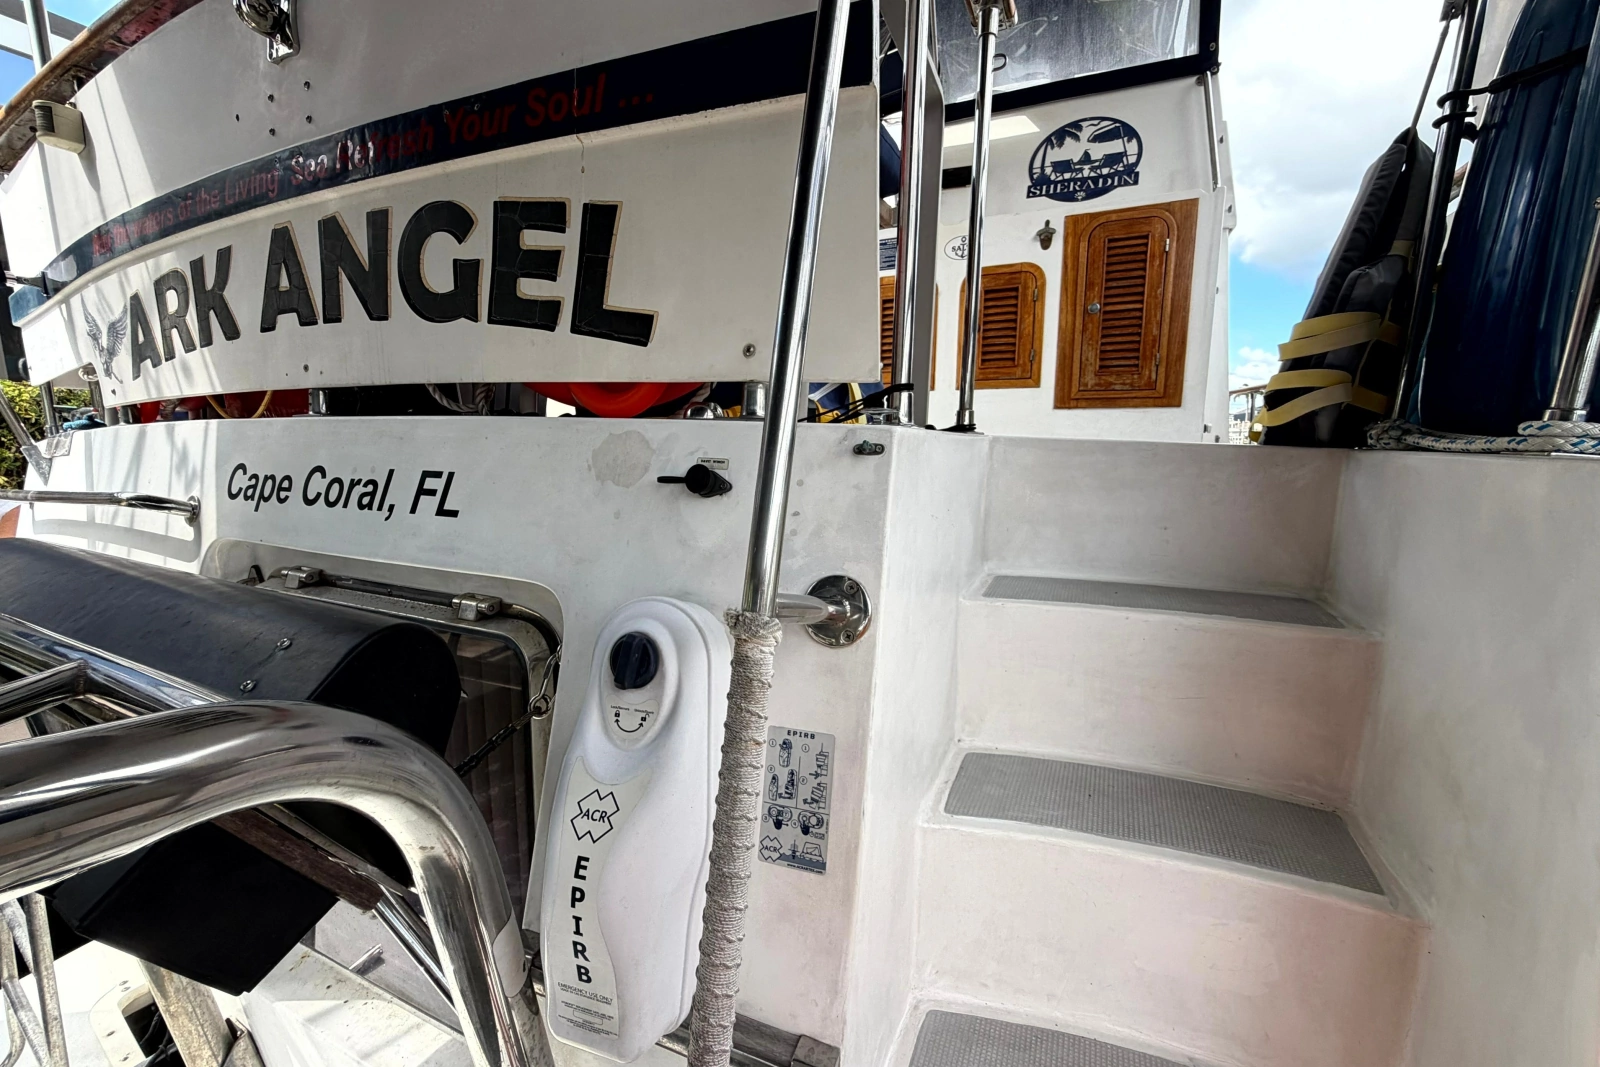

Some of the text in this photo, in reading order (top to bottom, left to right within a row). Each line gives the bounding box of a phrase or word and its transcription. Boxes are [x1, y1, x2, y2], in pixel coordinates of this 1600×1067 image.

[132, 207, 174, 237] waters
[177, 191, 192, 220] of
[195, 187, 220, 216] the
[224, 169, 280, 204] Living
[290, 154, 328, 185] Sea
[335, 123, 434, 174] Refresh
[443, 104, 517, 145] Your
[525, 73, 607, 127] Soul
[1028, 173, 1137, 198] SHERADIN
[130, 196, 659, 382] ARK ANGEL
[227, 462, 460, 522] Cape Coral, FL
[786, 729, 816, 740] EPIRB
[581, 808, 608, 824] ACR
[764, 844, 777, 853] ACR
[570, 855, 593, 984] EPIRB
